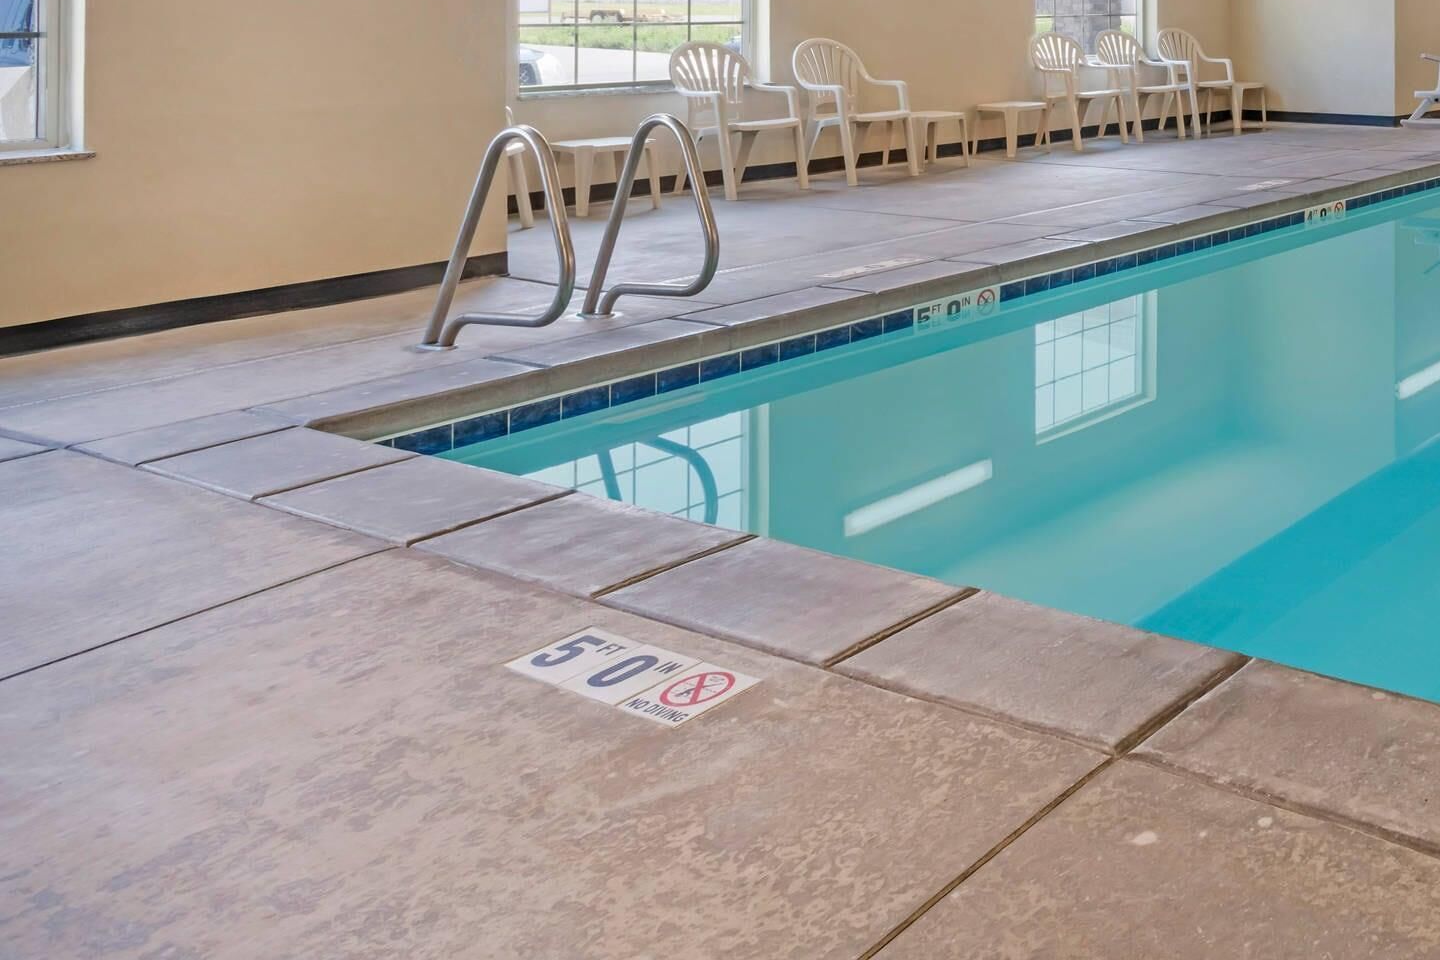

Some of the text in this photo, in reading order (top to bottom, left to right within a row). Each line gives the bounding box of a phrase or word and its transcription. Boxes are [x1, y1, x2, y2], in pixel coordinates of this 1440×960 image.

[917, 296, 971, 324] 5 FT 0 IN
[531, 634, 682, 688] 5 FT 0 IN
[626, 697, 690, 723] NO DIVING
